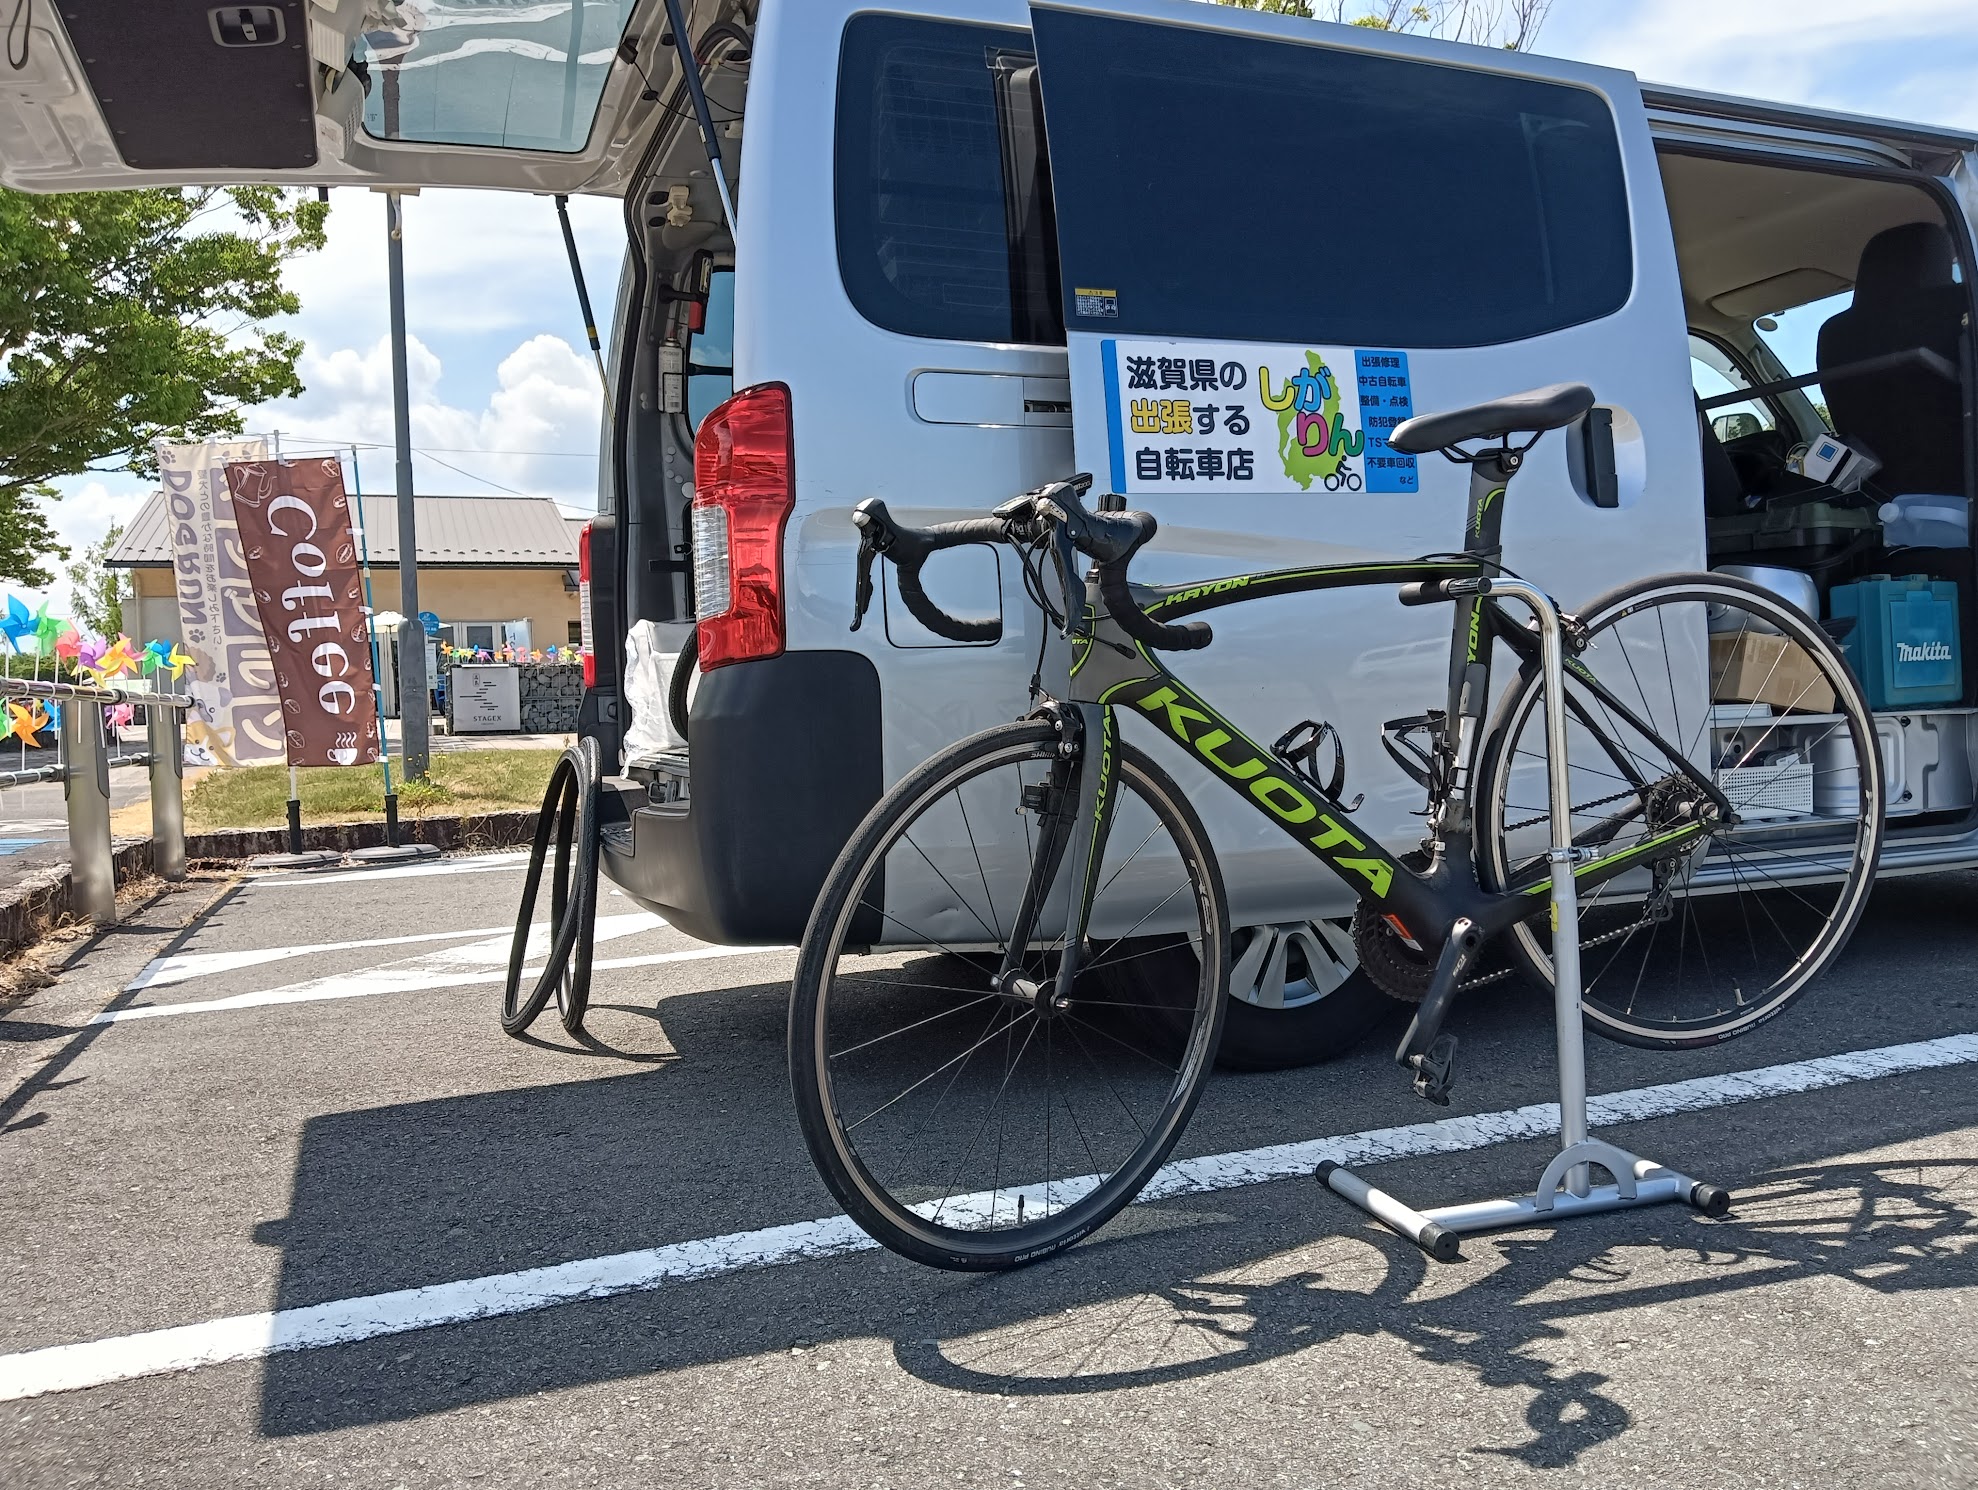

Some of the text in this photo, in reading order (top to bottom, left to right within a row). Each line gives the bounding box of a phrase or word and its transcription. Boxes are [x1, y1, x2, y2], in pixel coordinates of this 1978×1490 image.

[1126, 356, 1247, 391] 滋賀県の
[1361, 356, 1400, 368] 出張修理
[1259, 366, 1332, 412] しが
[1359, 376, 1407, 388] 中古自転車
[1130, 398, 1250, 435] 出張する
[1360, 395, 1409, 407] 整備・点検
[1296, 411, 1366, 457] りん
[1135, 447, 1254, 481] 自転車店
[1367, 457, 1415, 469] 不要車回収
[1399, 476, 1414, 485] など
[1474, 498, 1484, 538] KUOTA
[1467, 610, 1480, 665] YON
[1565, 658, 1597, 684] KUOTA
[1094, 716, 1112, 822] KUOTA
[1136, 686, 1395, 899] KUOTA
